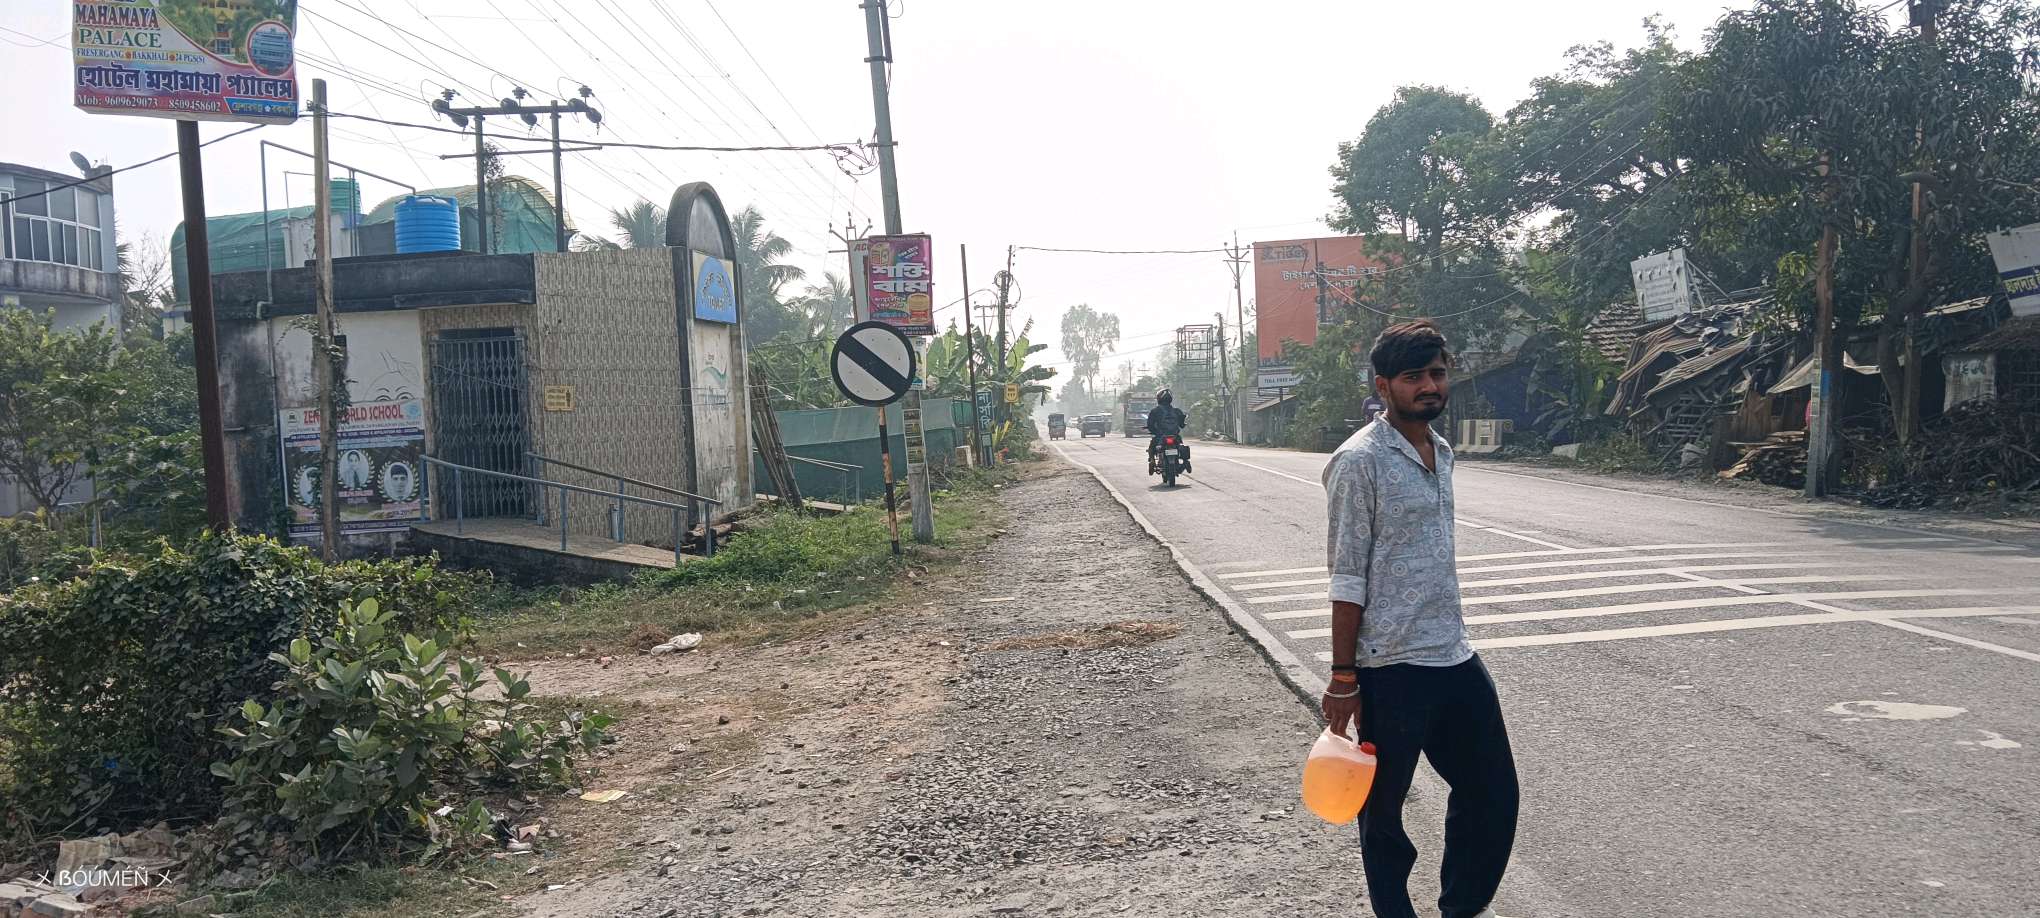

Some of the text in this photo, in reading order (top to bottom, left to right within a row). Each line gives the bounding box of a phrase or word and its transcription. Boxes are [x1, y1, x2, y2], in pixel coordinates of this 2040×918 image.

[75, 4, 159, 29] MAHAMAYA
[79, 28, 162, 48] PALACE
[132, 51, 169, 62] BAKKHALI
[77, 61, 293, 99] হোটেল মহামায়া প্যালেস
[77, 94, 221, 112] Mob: 9609629073 8509458602
[871, 262, 930, 278] শক্তি
[873, 280, 930, 293] বাম
[369, 404, 404, 421] SCHOOL
